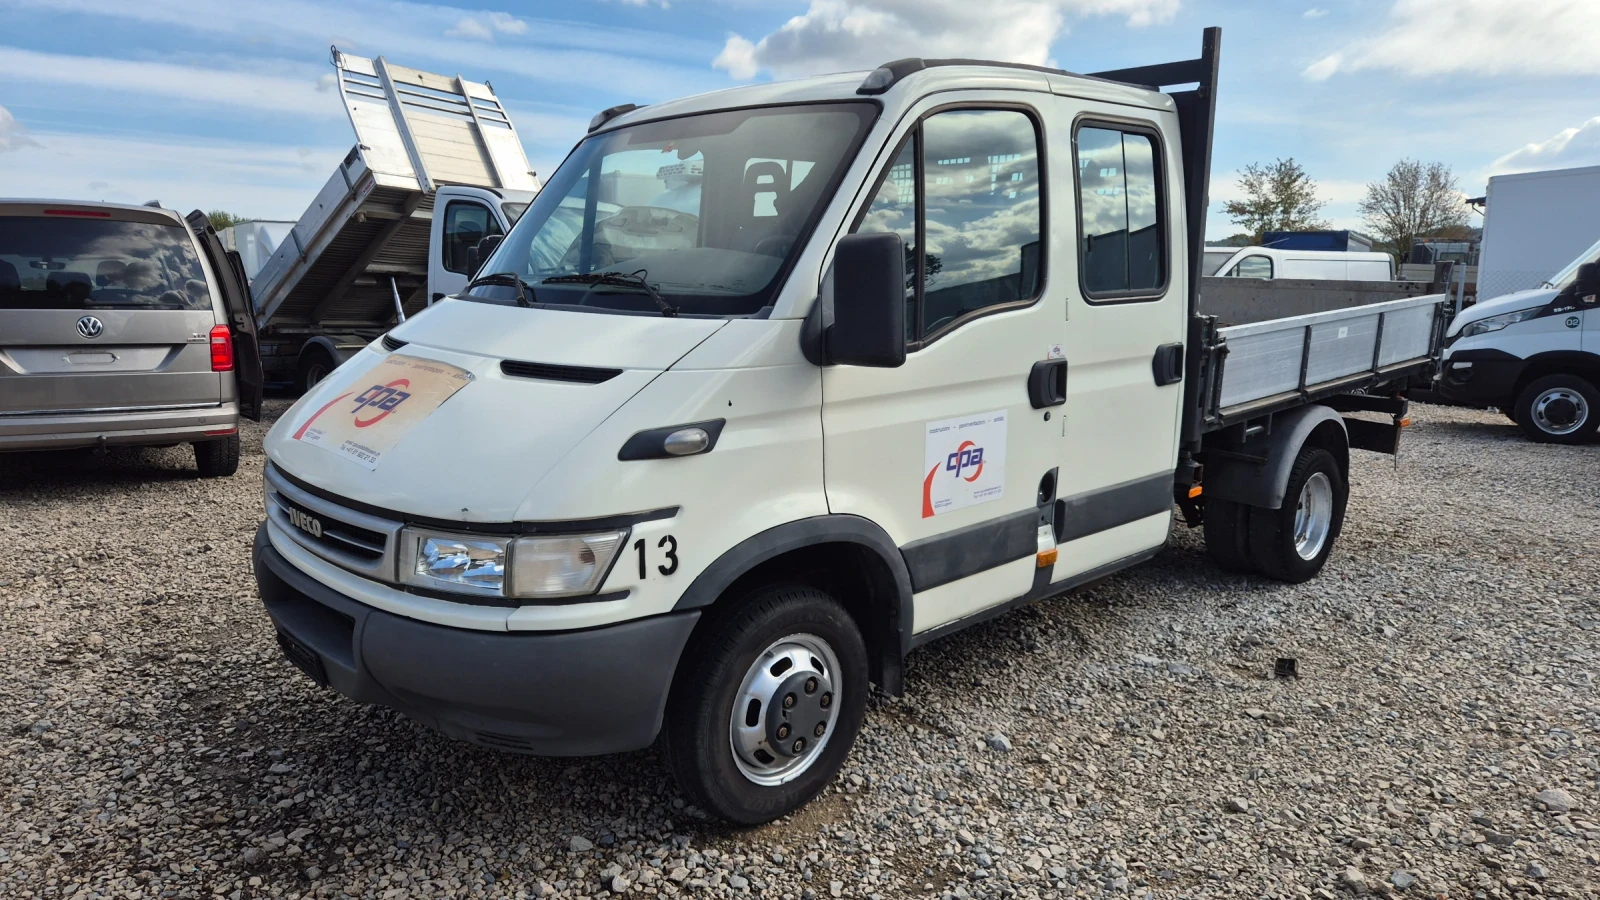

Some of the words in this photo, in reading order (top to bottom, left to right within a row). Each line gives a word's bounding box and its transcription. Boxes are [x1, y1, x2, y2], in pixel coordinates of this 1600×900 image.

[351, 384, 411, 414] cpa
[946, 447, 984, 478] cpa
[289, 506, 323, 538] IVECO
[633, 534, 679, 580] 13
